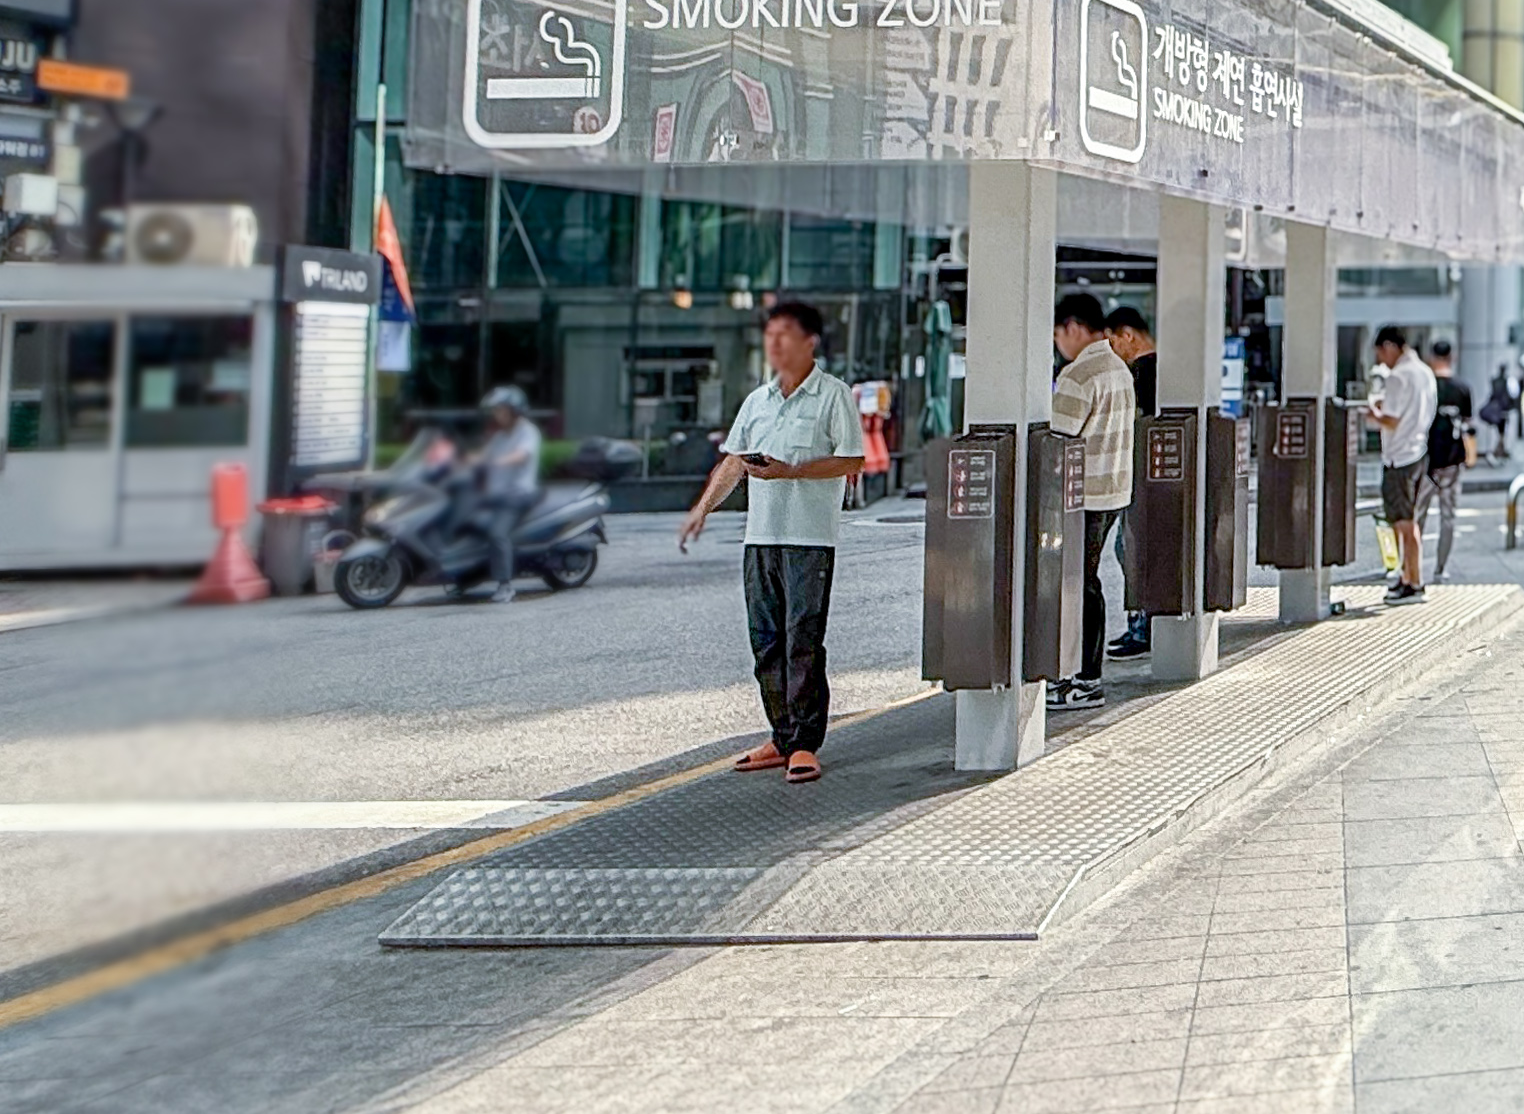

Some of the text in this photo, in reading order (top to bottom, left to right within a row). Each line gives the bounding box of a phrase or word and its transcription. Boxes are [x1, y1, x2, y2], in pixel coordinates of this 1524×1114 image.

[1152, 24, 1304, 128] 개방형 제연 흡연시설
[1153, 86, 1244, 143] SMOKING ZONE
